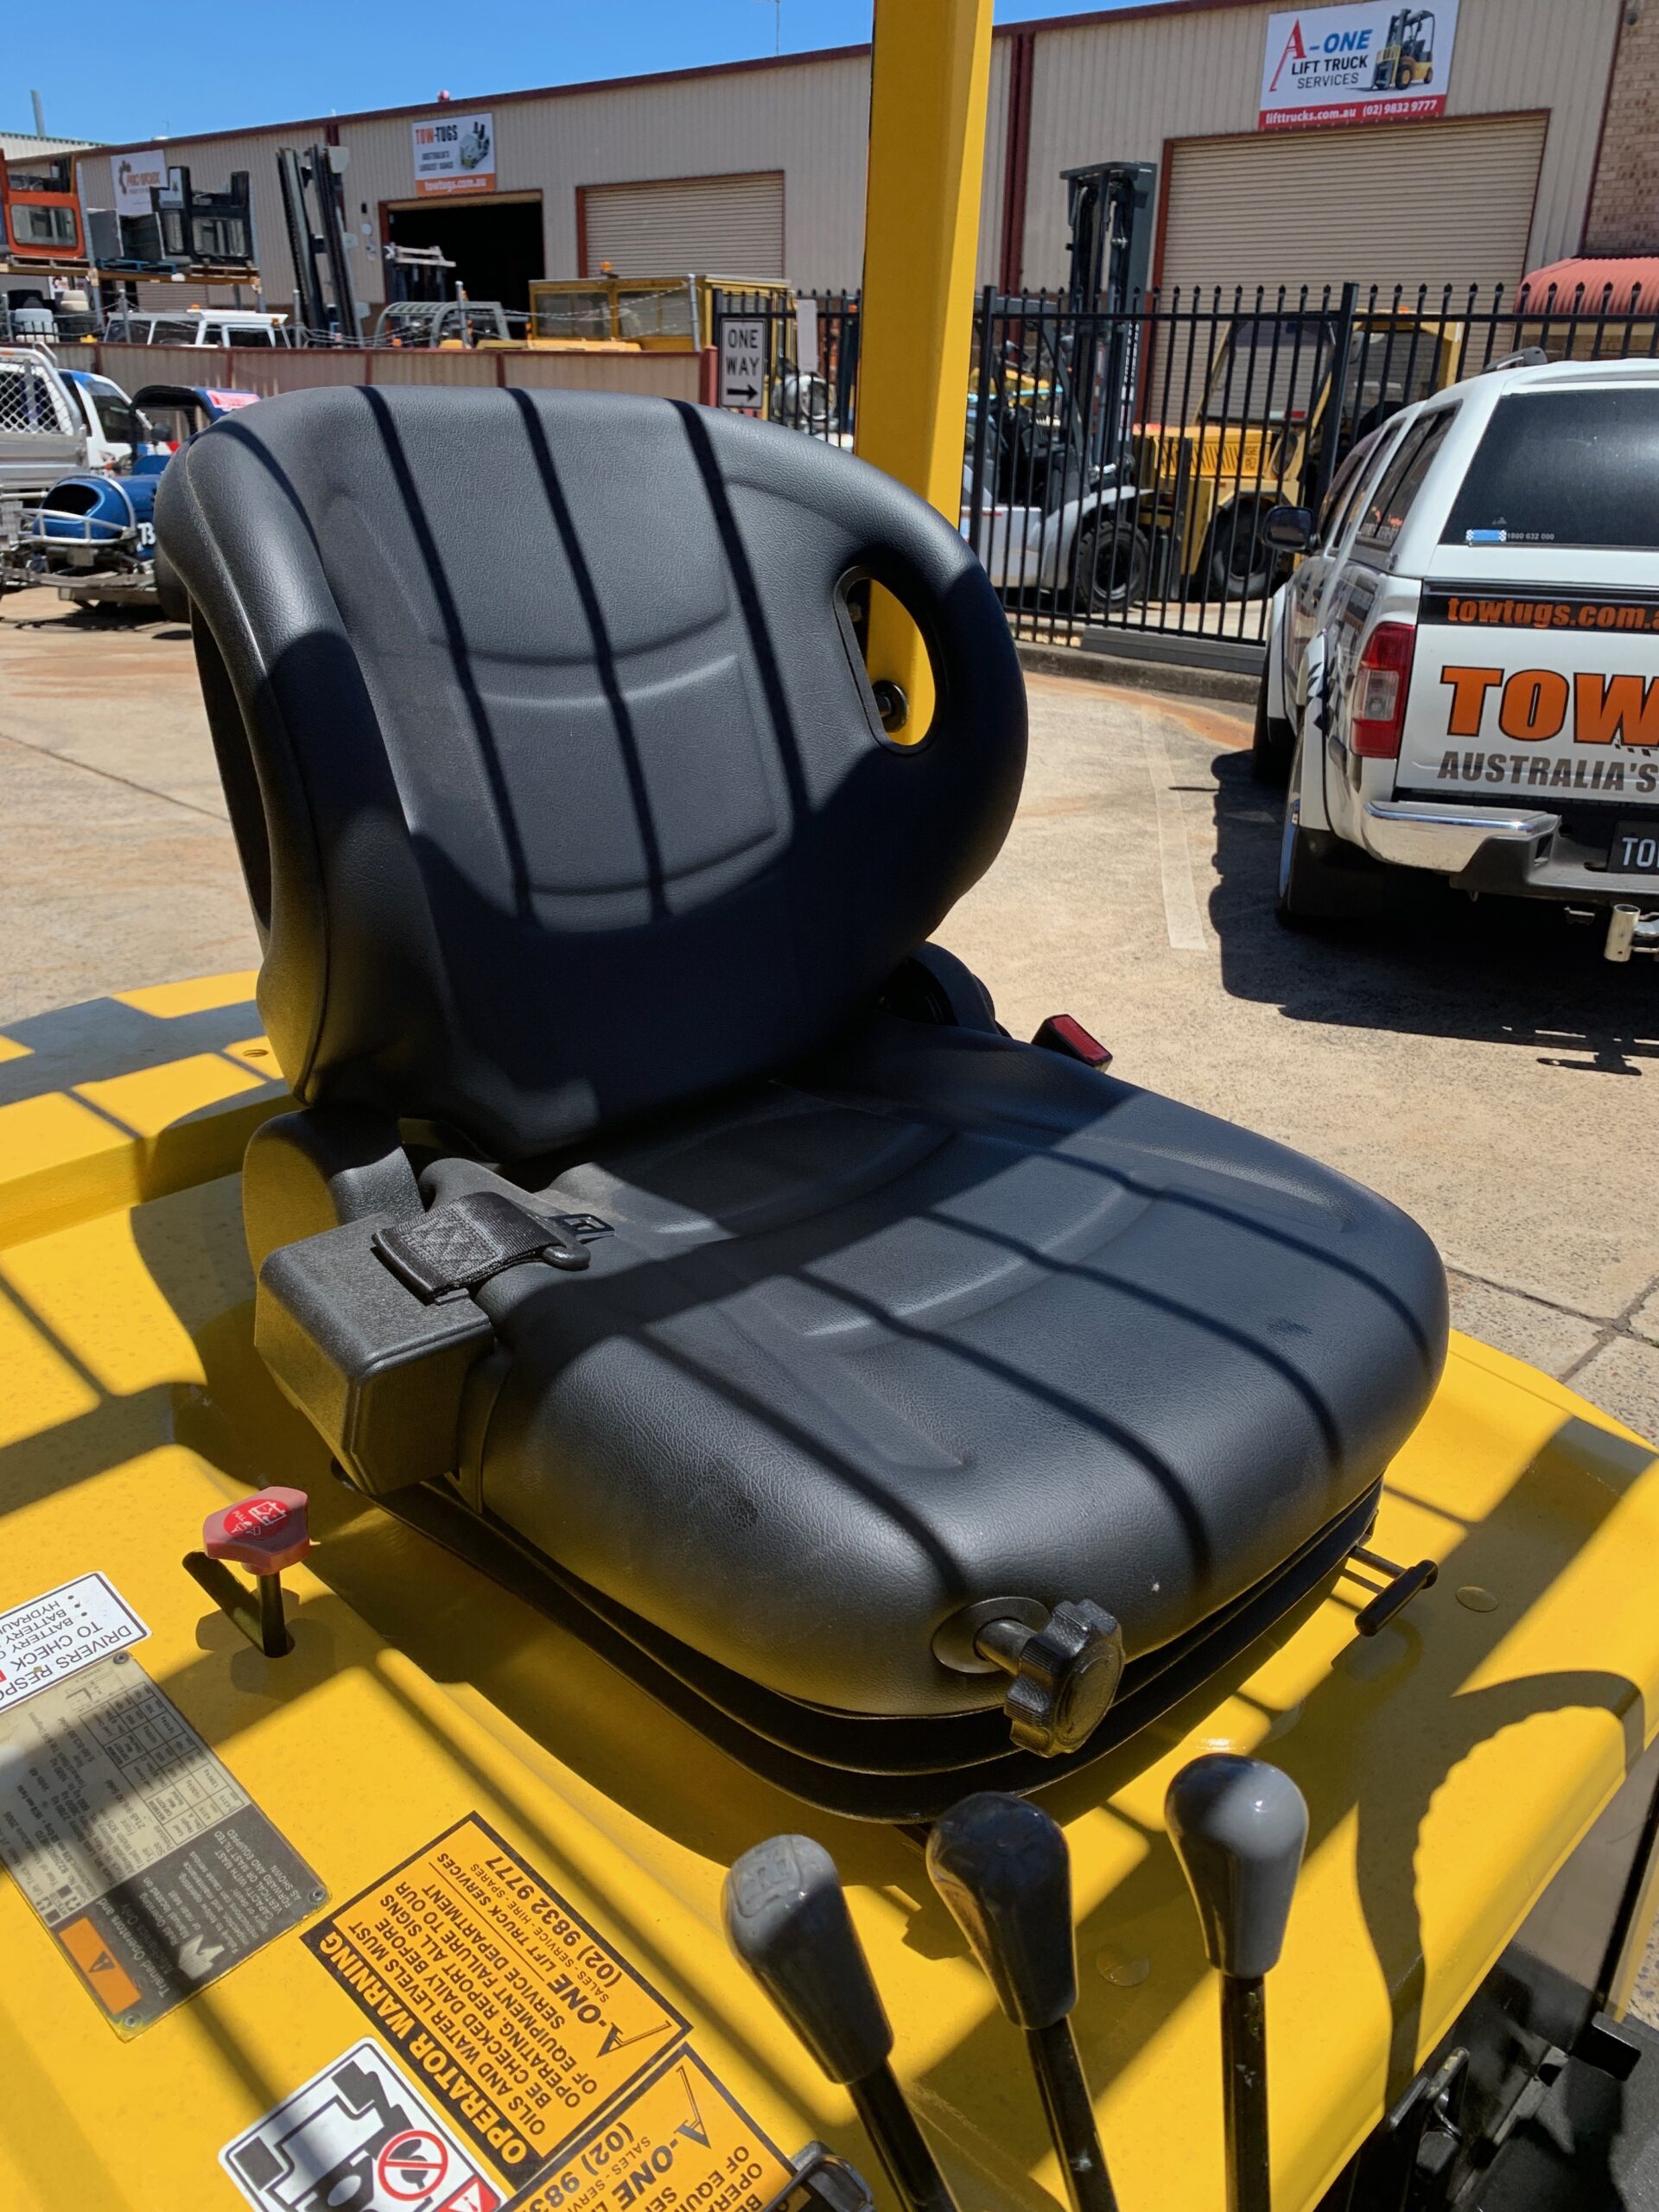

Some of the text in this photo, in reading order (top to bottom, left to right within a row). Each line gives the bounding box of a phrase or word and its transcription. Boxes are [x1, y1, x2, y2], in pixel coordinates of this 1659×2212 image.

[1269, 17, 1373, 92] A-ONE
[1292, 55, 1368, 75] LIFT TRUCK
[1297, 73, 1359, 89] SERVICES
[1266, 99, 1437, 124] lifttrucks.com.au (02) 9832 9777
[415, 124, 458, 144] TOW-TUGS
[728, 329, 759, 348] ONE
[726, 357, 760, 376] WAY
[1440, 665, 1659, 747] TOW
[1438, 750, 1659, 793] AUSTRALIA'S
[1621, 837, 1659, 869] TO
[0, 1600, 60, 1636] HYDRAU
[6, 1609, 67, 1644] BATTERY
[12, 1618, 73, 1653] BATTERY
[77, 1621, 103, 1638] TO
[10, 1635, 73, 1672] CHECK
[55, 1625, 132, 1669] DRIVERS
[213, 1829, 235, 1853] TILTED
[226, 1828, 255, 1860] EQUIPPED
[181, 1859, 215, 1900] maintenance
[188, 1850, 209, 1873] serious
[230, 1851, 251, 1873] MAST
[245, 1870, 259, 1883] OR
[250, 1858, 267, 1876] AND
[205, 1872, 224, 1892] cause
[214, 1848, 276, 1922] CAPACITY WITH MAST
[219, 1890, 232, 1904] can
[254, 1880, 284, 1915] VERTICAL
[262, 1873, 294, 1909] FORWARD
[269, 1864, 302, 1902] AS SHOWN
[137, 1891, 181, 1947] Read Operating
[143, 1876, 191, 1939] Manual located on
[168, 1890, 202, 1931] or near seat
[199, 1902, 219, 1924] follow
[211, 1898, 225, 1913] and
[485, 1856, 622, 1988] (02) 9832 9777
[118, 1901, 175, 1975] Mechanics Only
[213, 1922, 225, 1932] to
[219, 1929, 241, 1955] Failure
[470, 1864, 609, 2003] SALES SERVICE HIRE SPARES
[95, 1897, 172, 1998] Trained Operators and
[421, 1884, 565, 2030] SERVICE DEPARTMENT
[437, 1853, 672, 2058] A-ONE LIFT TRUCK SERVICES
[380, 1895, 581, 2107] OPERATING. REPORT ALL SIGNS
[395, 1881, 597, 2094] OF EQUIPMENT FAILURE TO OUR
[348, 1922, 545, 2135] OILS AND WATER LEVELS MUST
[374, 1917, 552, 2109] BE CHECKED DAILY BEFORE
[320, 1931, 526, 2164] OPERATOR WARNING
[581, 2065, 711, 2211] A-ONE
[581, 2121, 634, 2176] (02)
[612, 2137, 651, 2175] SALES
[726, 2146, 749, 2174] OF
